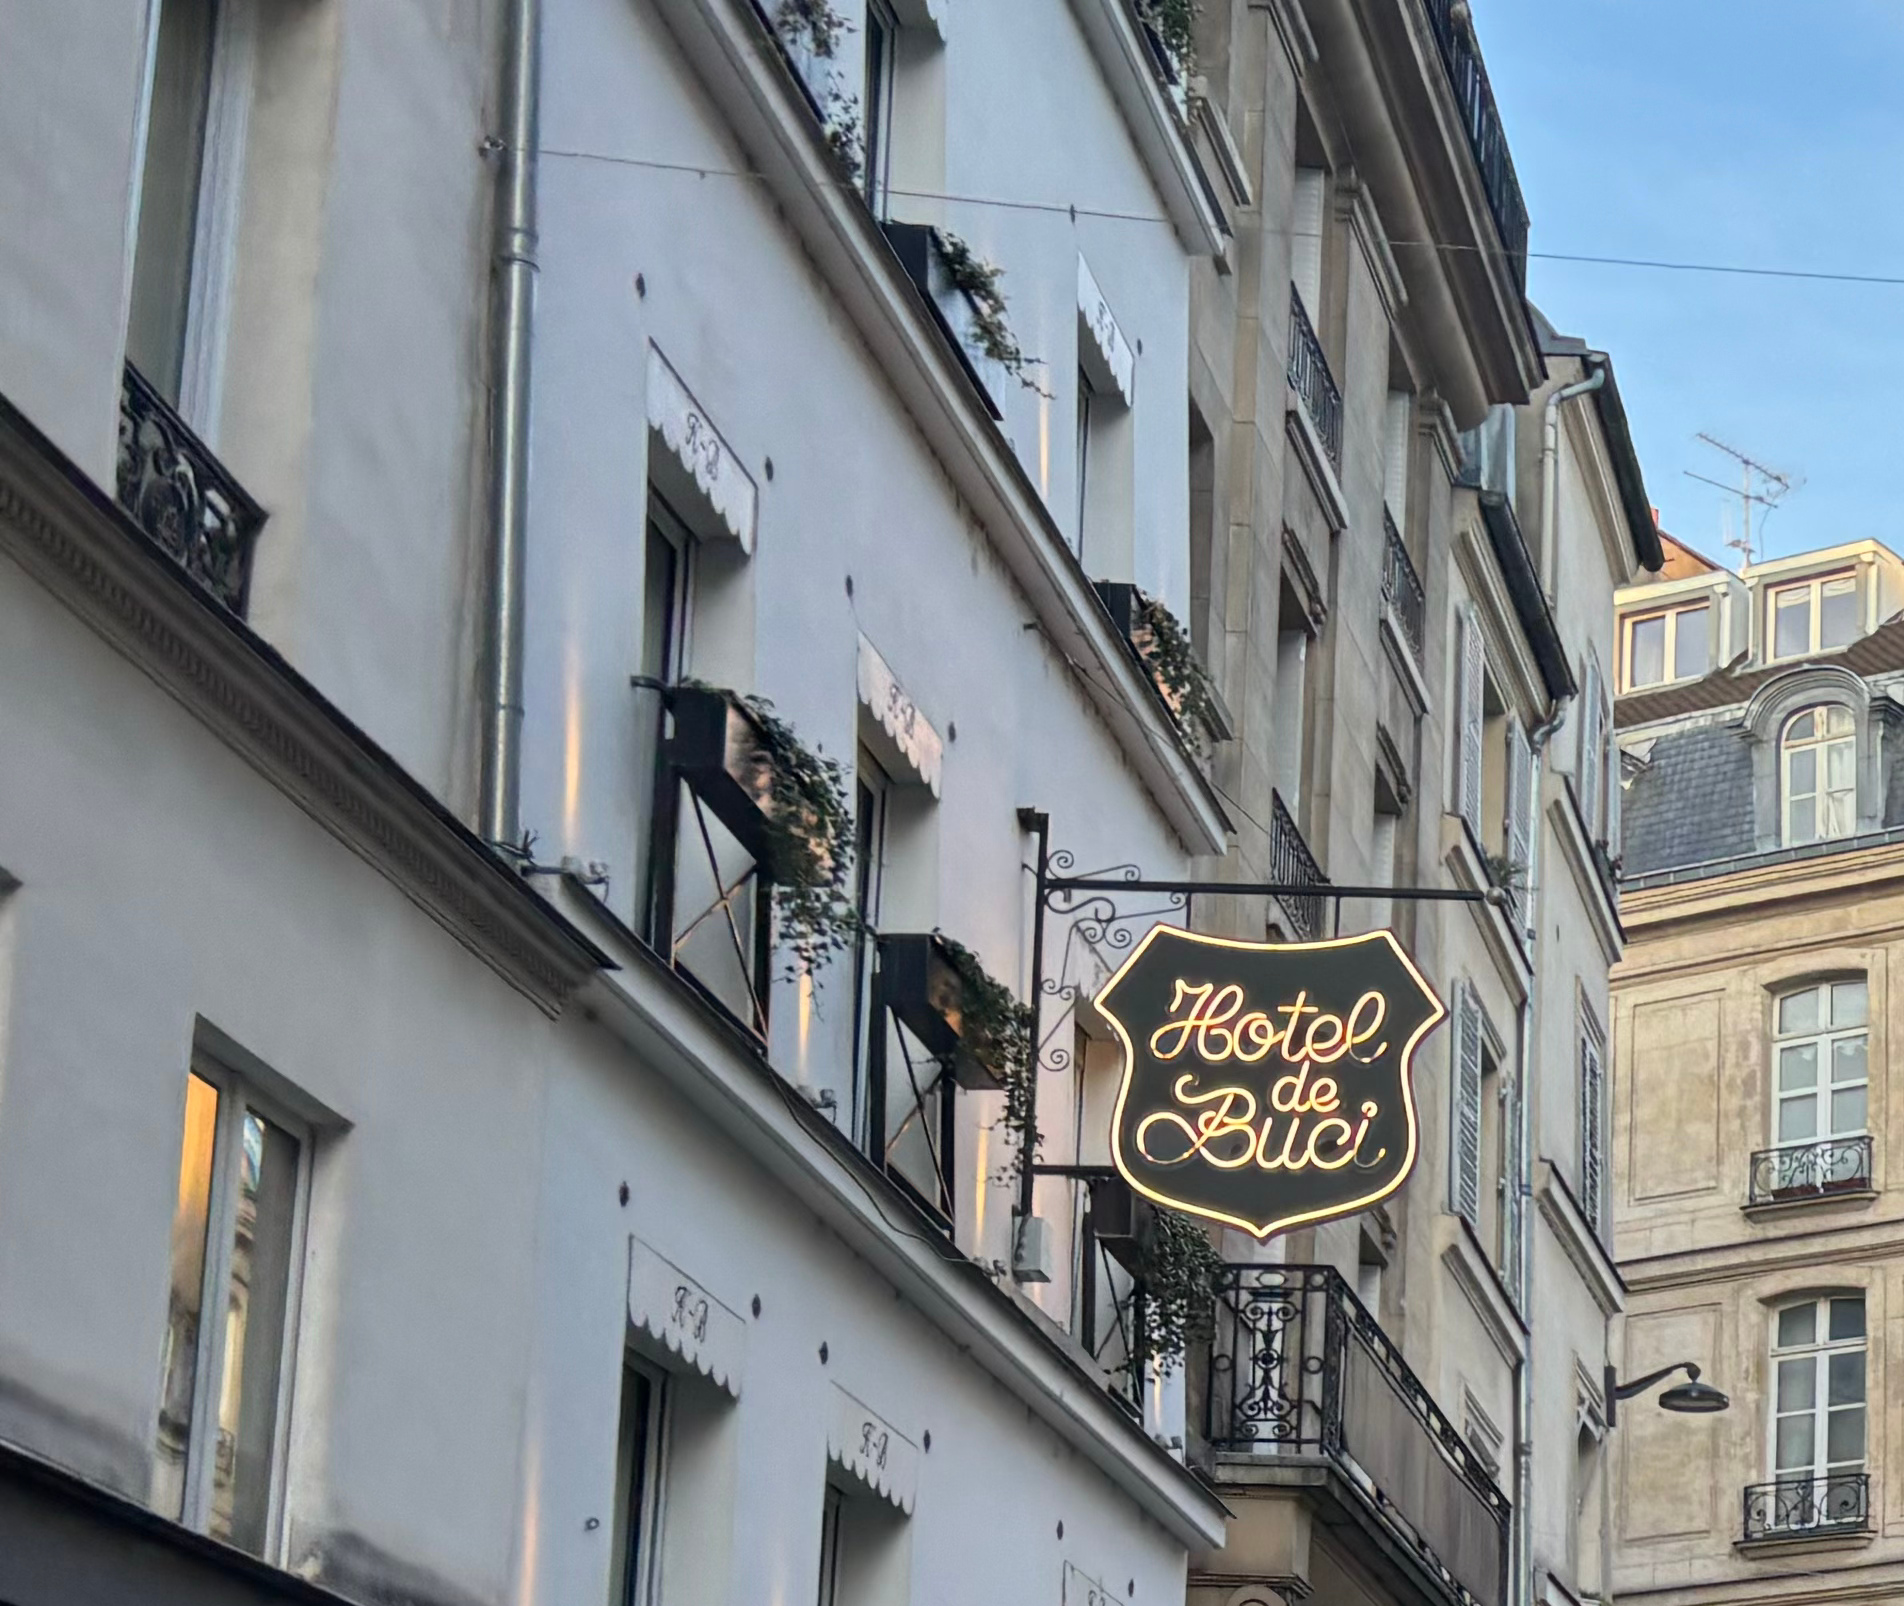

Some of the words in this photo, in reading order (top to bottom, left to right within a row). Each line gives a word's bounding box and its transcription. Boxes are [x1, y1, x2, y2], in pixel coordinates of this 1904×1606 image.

[1150, 979, 1388, 1063] Hotel
[1137, 1074, 1386, 1169] Buci
[1271, 1061, 1340, 1112] de
